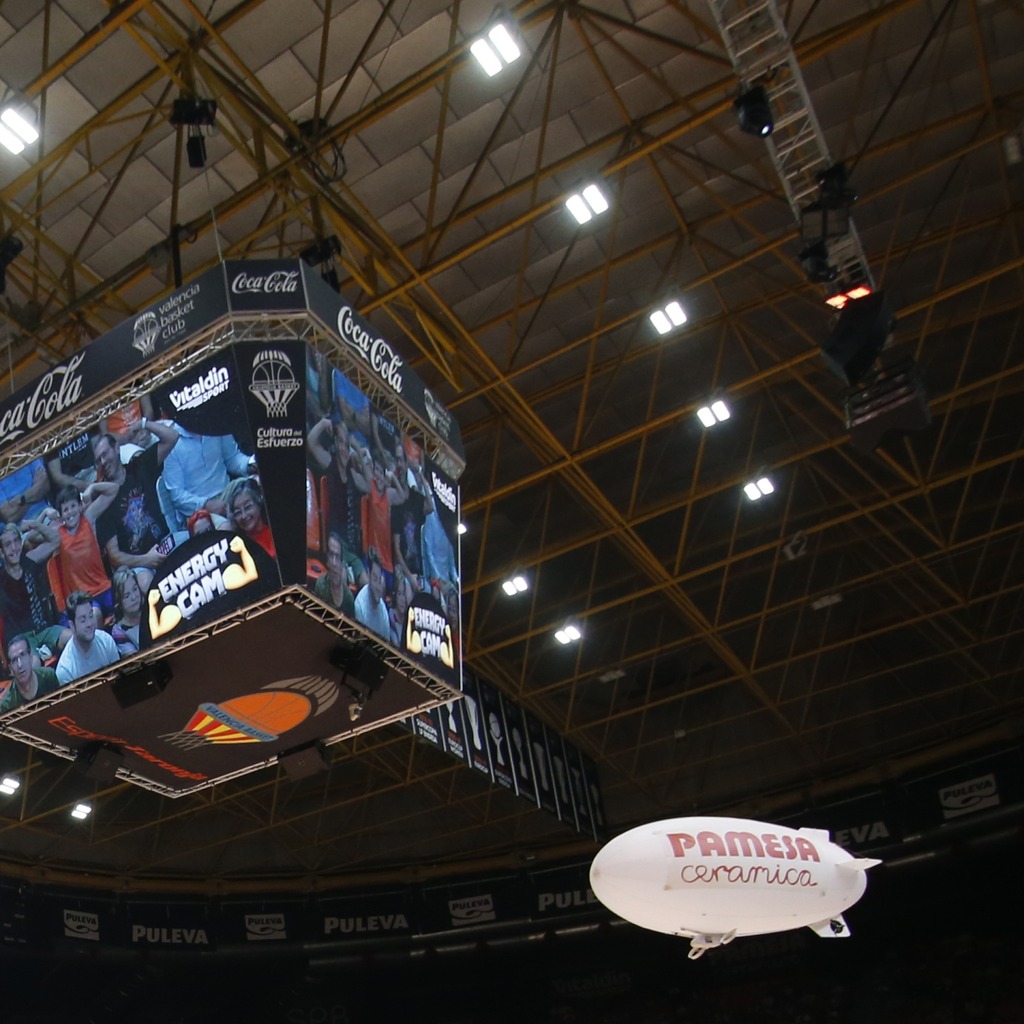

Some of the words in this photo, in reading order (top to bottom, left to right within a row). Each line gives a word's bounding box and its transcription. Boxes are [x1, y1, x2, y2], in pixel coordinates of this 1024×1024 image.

[232, 270, 300, 294] Coca-Cola
[158, 282, 201, 315] valencia
[159, 300, 195, 328] basket
[162, 317, 186, 340] club
[337, 305, 403, 394] Coca-Cola
[168, 366, 229, 409] Vitaldin
[202, 379, 230, 403] SPORT
[257, 427, 293, 438] Cultura
[257, 437, 303, 448] Esfuerzo
[157, 538, 229, 603] ENERGY
[177, 568, 227, 620] CAM
[414, 607, 446, 636] ENERGY
[420, 630, 441, 658] CAM
[943, 779, 993, 800] PULEVA
[835, 821, 890, 846] EVA
[666, 831, 821, 862] PAMESA
[451, 898, 491, 911] PULEVA
[65, 912, 98, 927] PULEVA
[248, 917, 283, 926] PULEVA
[324, 914, 408, 934] PULEVA
[132, 924, 208, 945] PULEVA
